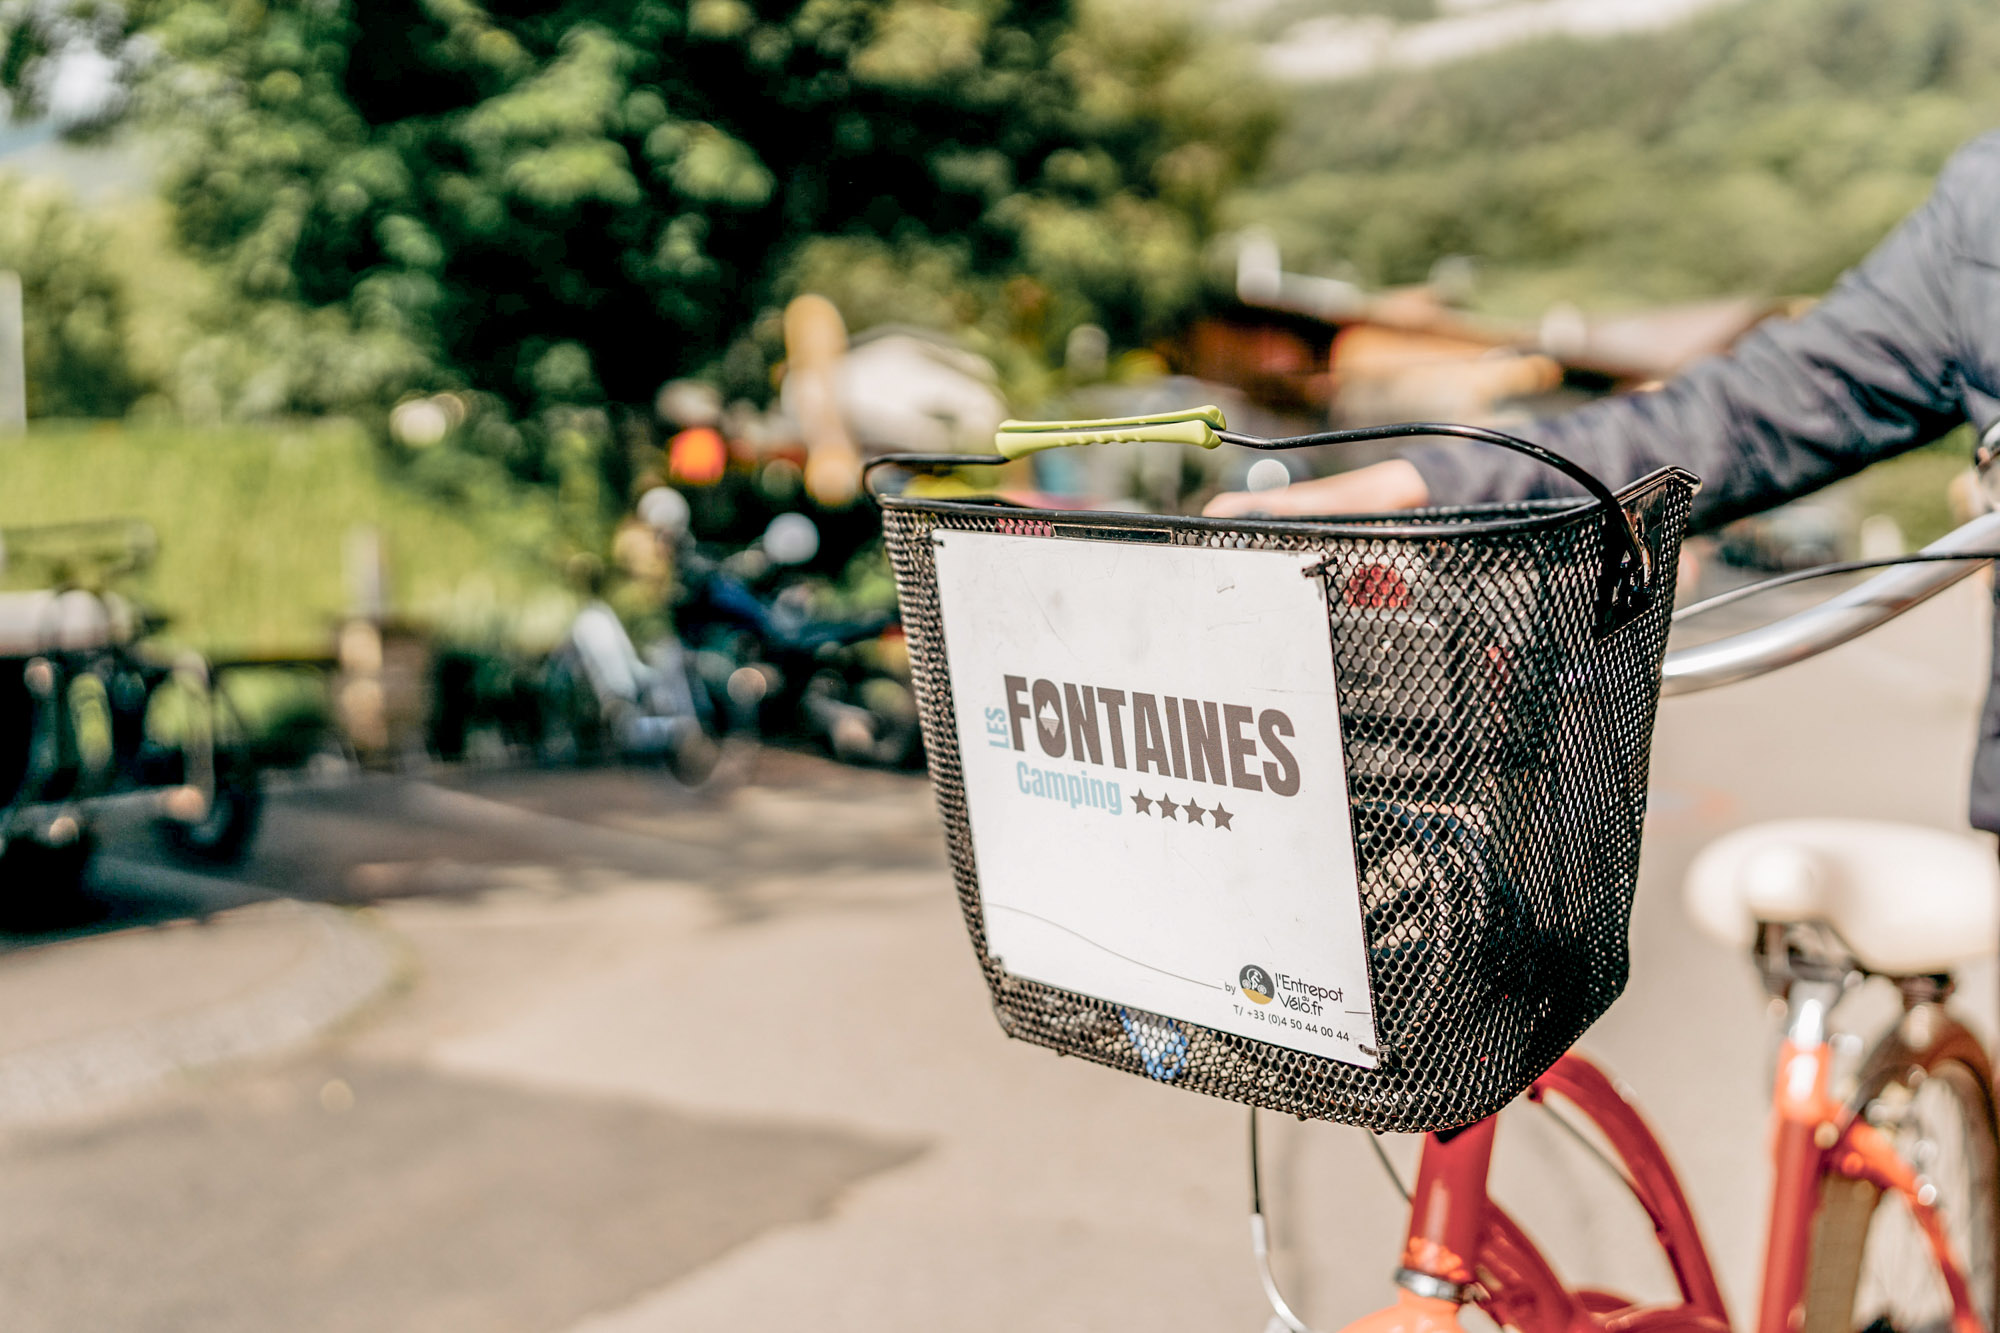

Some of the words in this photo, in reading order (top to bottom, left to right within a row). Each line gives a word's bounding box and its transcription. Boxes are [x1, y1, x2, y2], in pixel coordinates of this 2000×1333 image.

[985, 706, 1009, 749] LES
[1003, 674, 1300, 797] FONTAINES
[1017, 761, 1122, 815] Camping
[1225, 981, 1236, 995] by
[1275, 973, 1343, 1002] l'Entrepot
[1278, 992, 1324, 1016] Vélo.fr
[1233, 1004, 1244, 1016] T/
[1247, 1009, 1265, 1021] +33
[1268, 1013, 1287, 1026] (0)4
[1290, 1019, 1302, 1030] 50
[1305, 1023, 1318, 1033] 44
[1321, 1026, 1333, 1038] 00
[1336, 1031, 1349, 1041] 44
